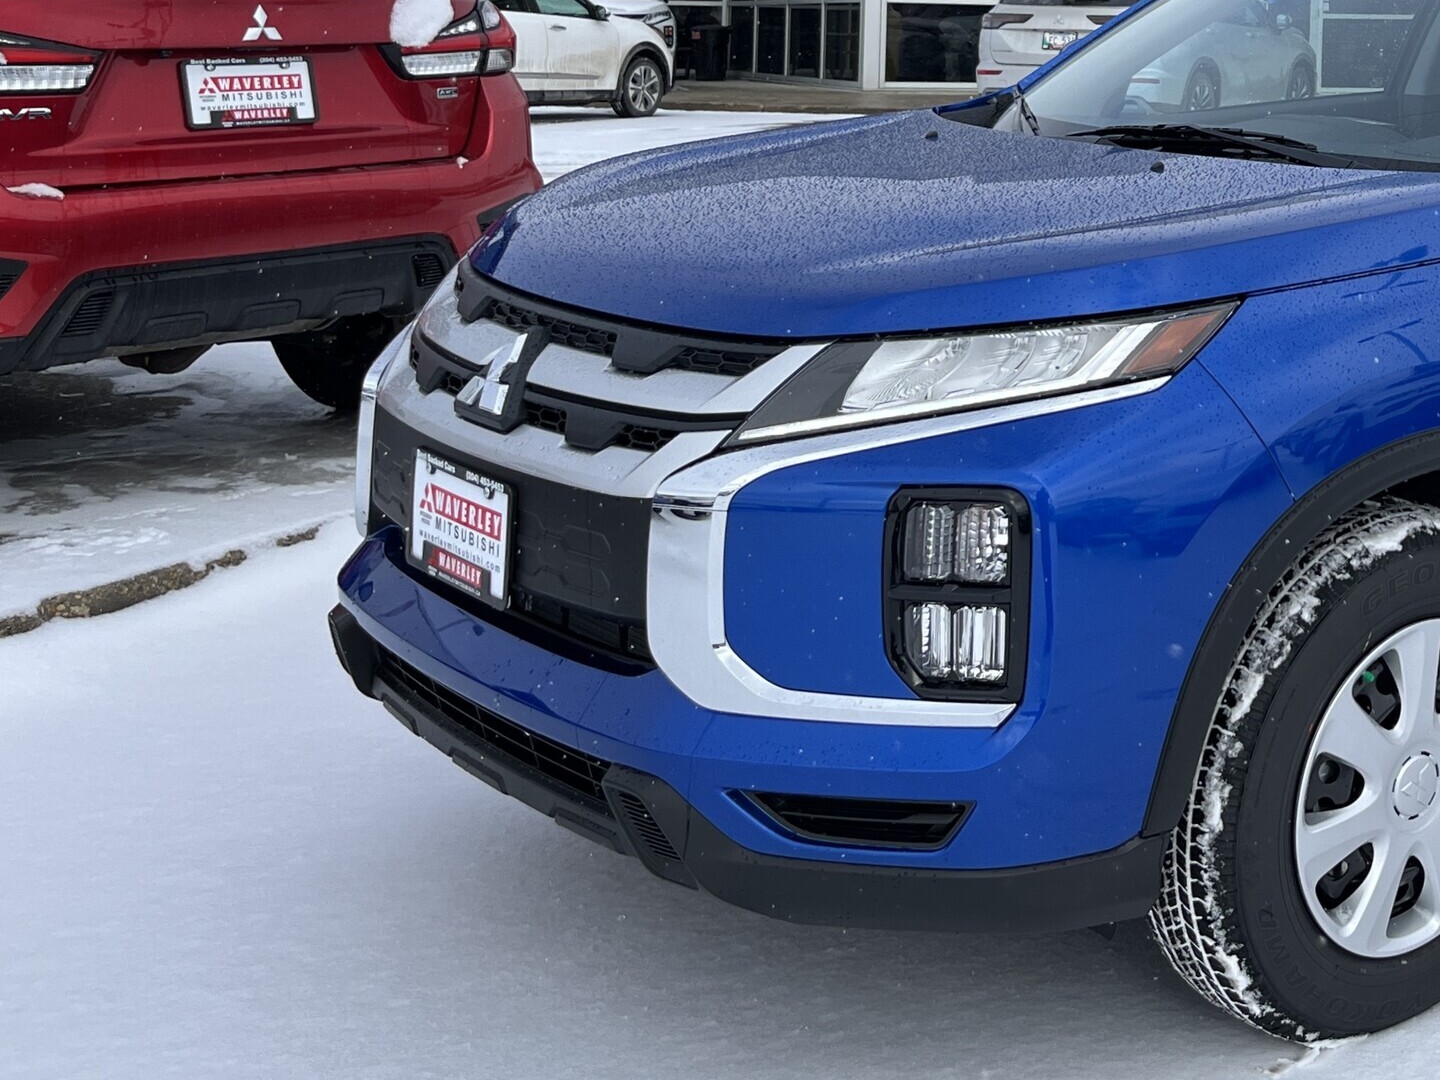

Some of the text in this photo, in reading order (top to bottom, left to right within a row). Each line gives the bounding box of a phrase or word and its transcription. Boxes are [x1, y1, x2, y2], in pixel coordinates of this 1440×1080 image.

[218, 75, 300, 91] WAVERLEY
[221, 90, 303, 102] MITSUBISHI
[0, 107, 52, 120] VR
[233, 109, 288, 119] WAVERLEY
[435, 489, 502, 537] WAVERLEY
[435, 516, 500, 558] MITSUBISHI
[419, 529, 501, 573] waverleymitsubishi.com
[438, 551, 482, 585] WAVERLEY
